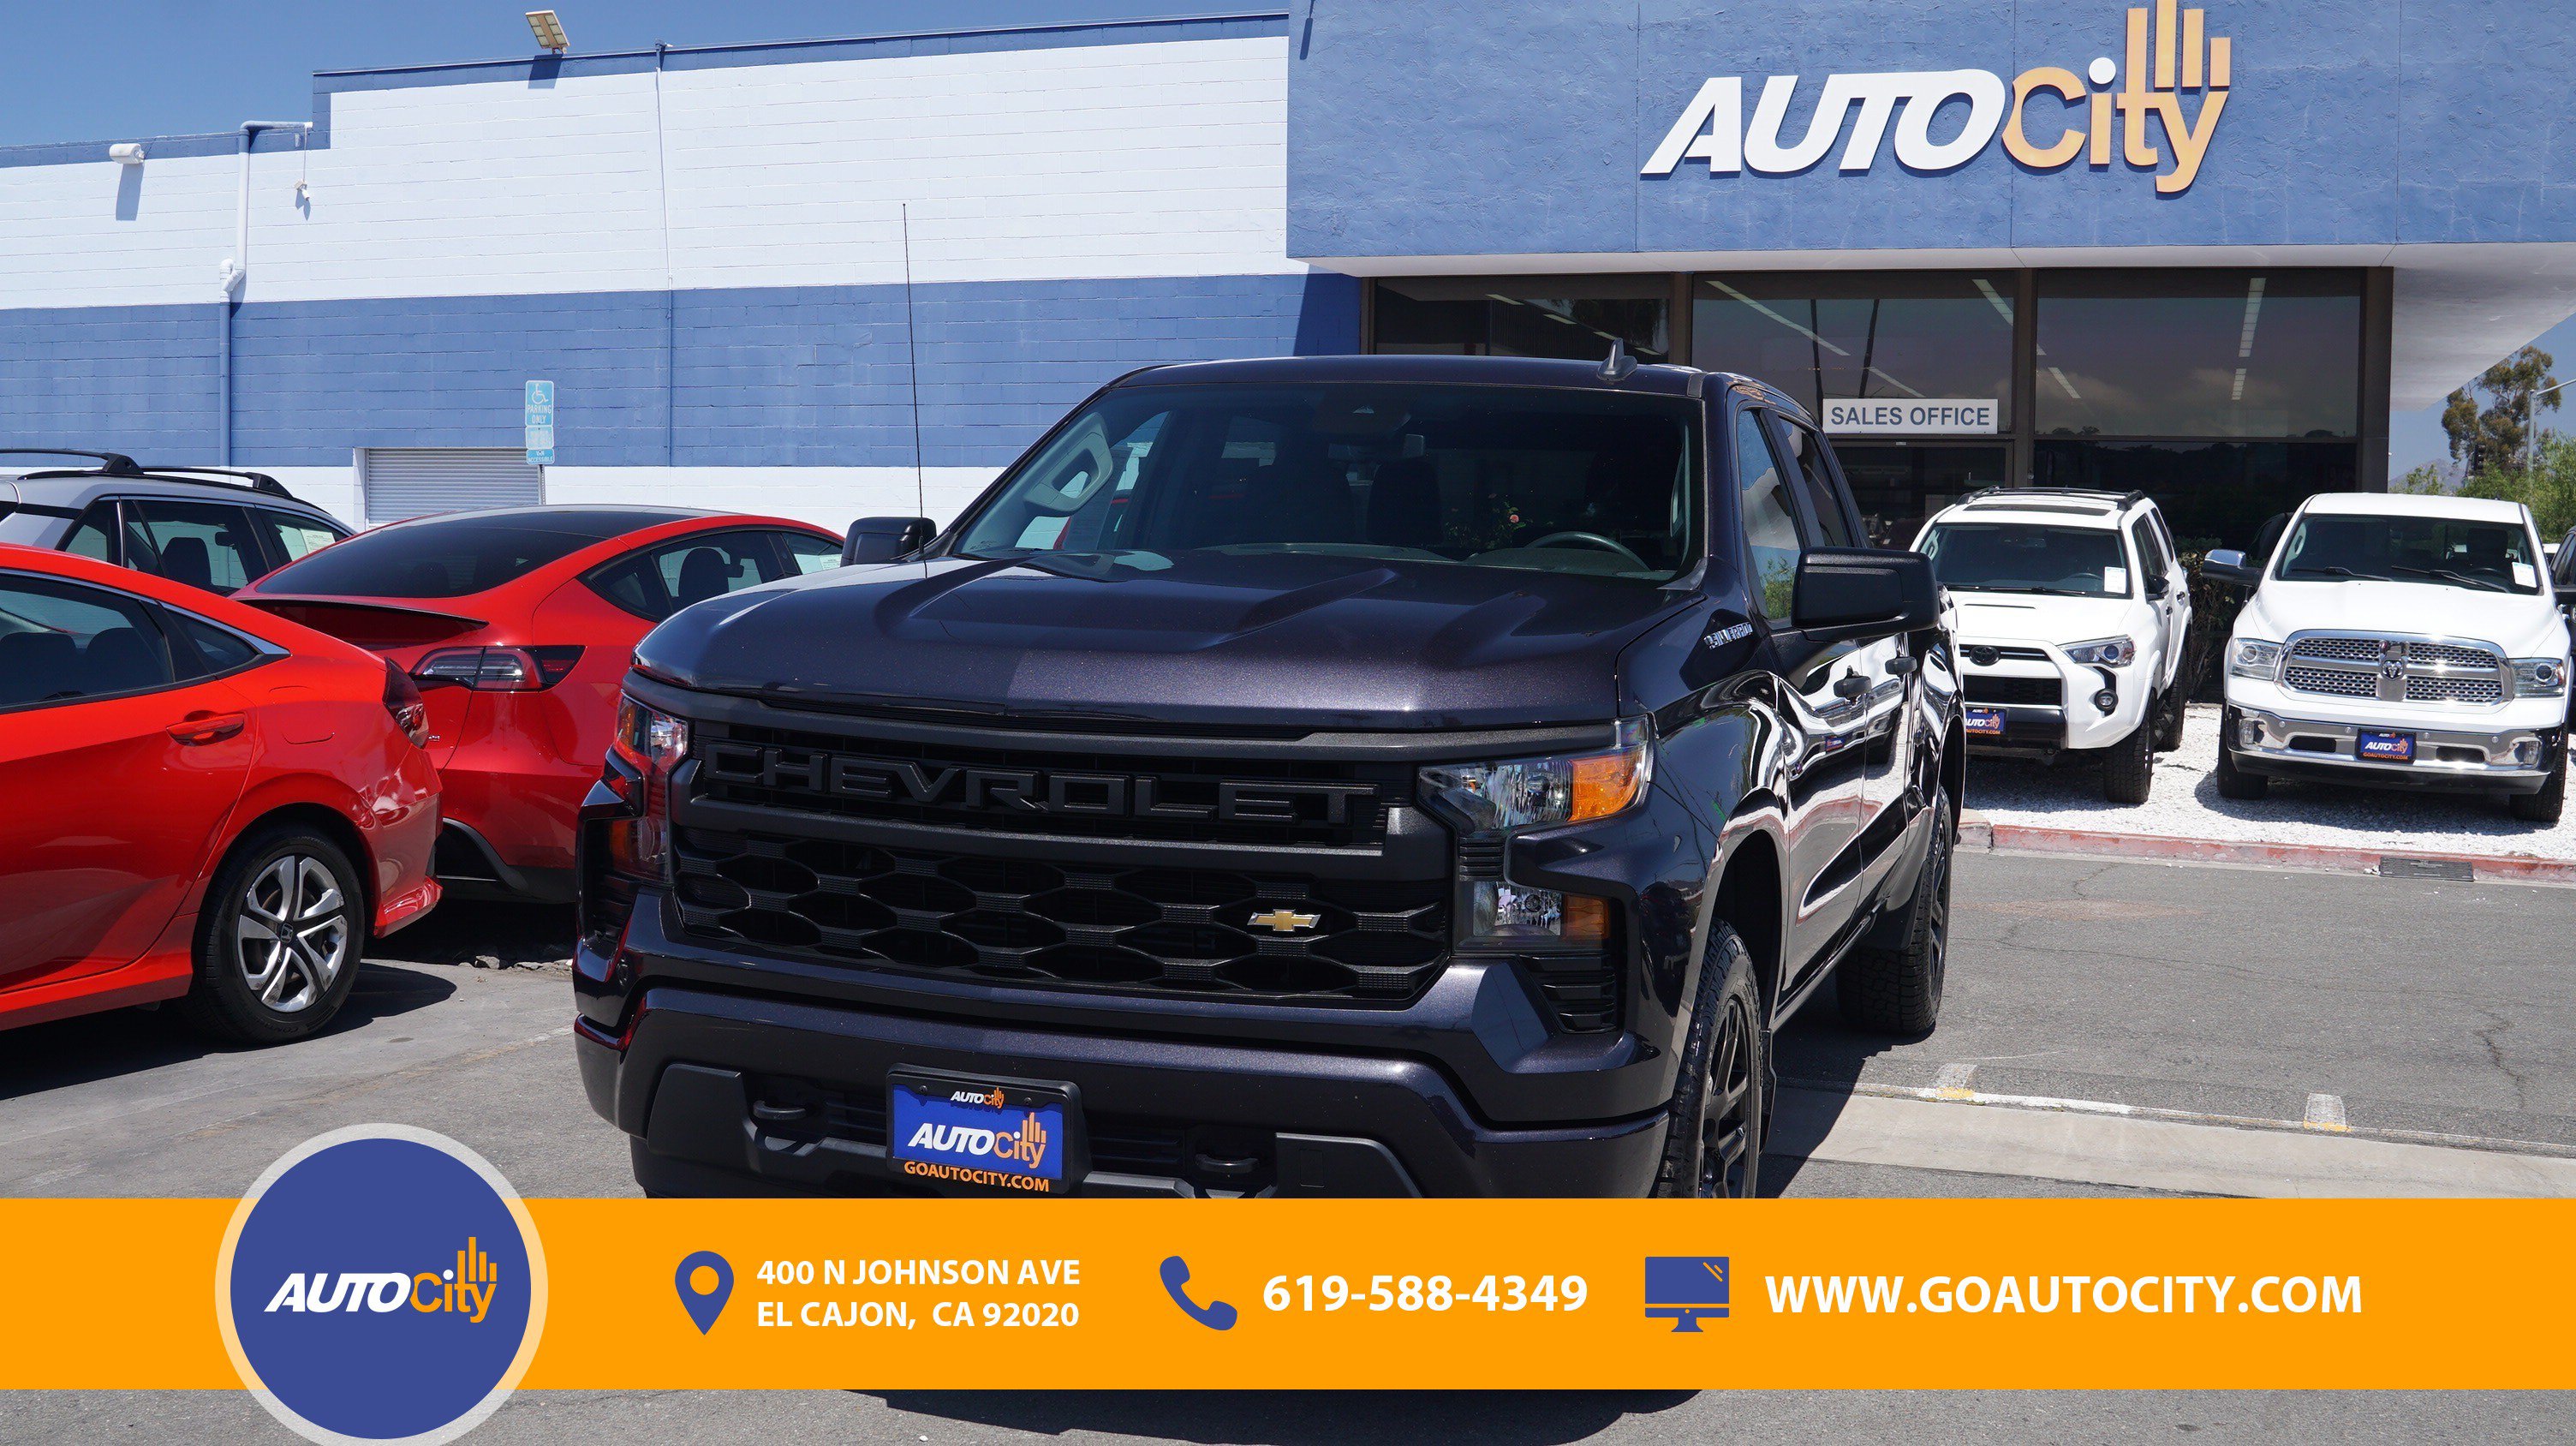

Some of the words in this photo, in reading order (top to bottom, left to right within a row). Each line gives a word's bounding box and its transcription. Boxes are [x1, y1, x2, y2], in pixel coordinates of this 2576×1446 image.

[527, 404, 552, 414] PARKING
[1831, 406, 1903, 426] SALES
[1910, 407, 1990, 427] OFFICE
[532, 415, 547, 424] ONLY
[1965, 714, 2000, 729] UTOCity
[705, 741, 1382, 826] CHEVROLET
[903, 1161, 1050, 1192] GOAUTOCITY.COM
